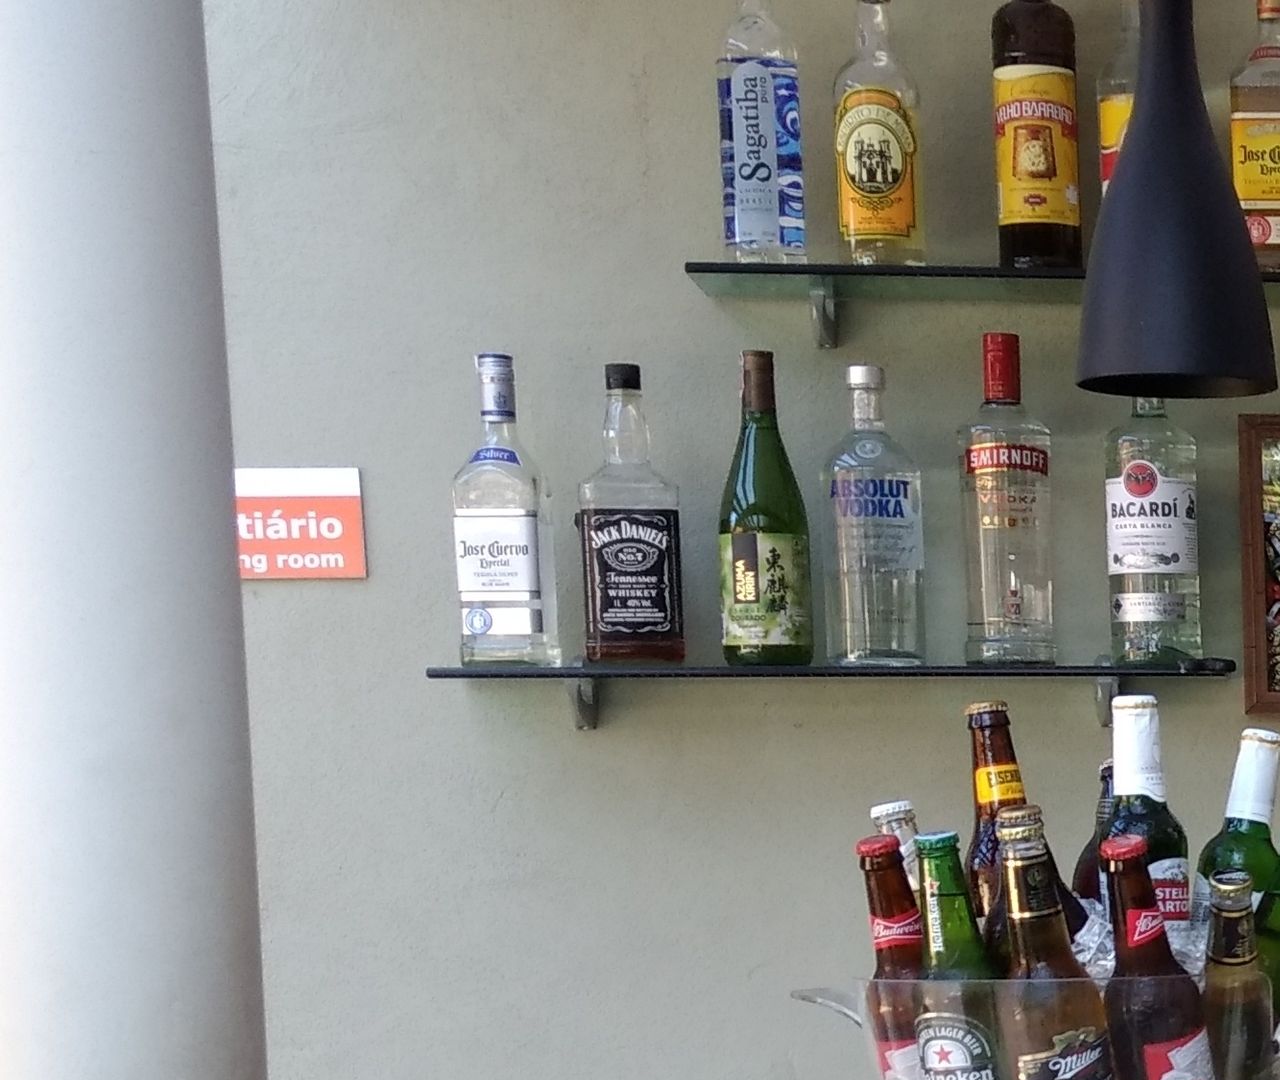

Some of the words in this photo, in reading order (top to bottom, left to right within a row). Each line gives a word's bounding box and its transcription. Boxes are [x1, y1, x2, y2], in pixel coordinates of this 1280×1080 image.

[759, 76, 769, 103] puro
[736, 76, 772, 182] Sagatiba
[1240, 144, 1267, 165] Jose
[970, 448, 1045, 468] SMIRNOFF
[830, 479, 909, 499] ABSOLUT
[838, 499, 905, 518] VODKA
[1111, 497, 1178, 519] BACARDÍ
[237, 509, 343, 540] tiário
[591, 525, 621, 549] JACK
[620, 520, 670, 551] DANIEL'S
[459, 540, 486, 558] Jose
[488, 540, 529, 558] Cuervo
[276, 553, 344, 568] room
[606, 571, 657, 583] Tennessee
[735, 560, 746, 601] AZUMA
[745, 571, 756, 601] KIRIN
[607, 588, 657, 597] WHISKEY
[1155, 887, 1190, 900] STELL
[1158, 900, 1188, 913] ARTO
[929, 896, 945, 952] Heineken
[936, 1027, 965, 1041] LAGER
[963, 1033, 982, 1056] BEER
[1048, 1047, 1102, 1080] Miller
